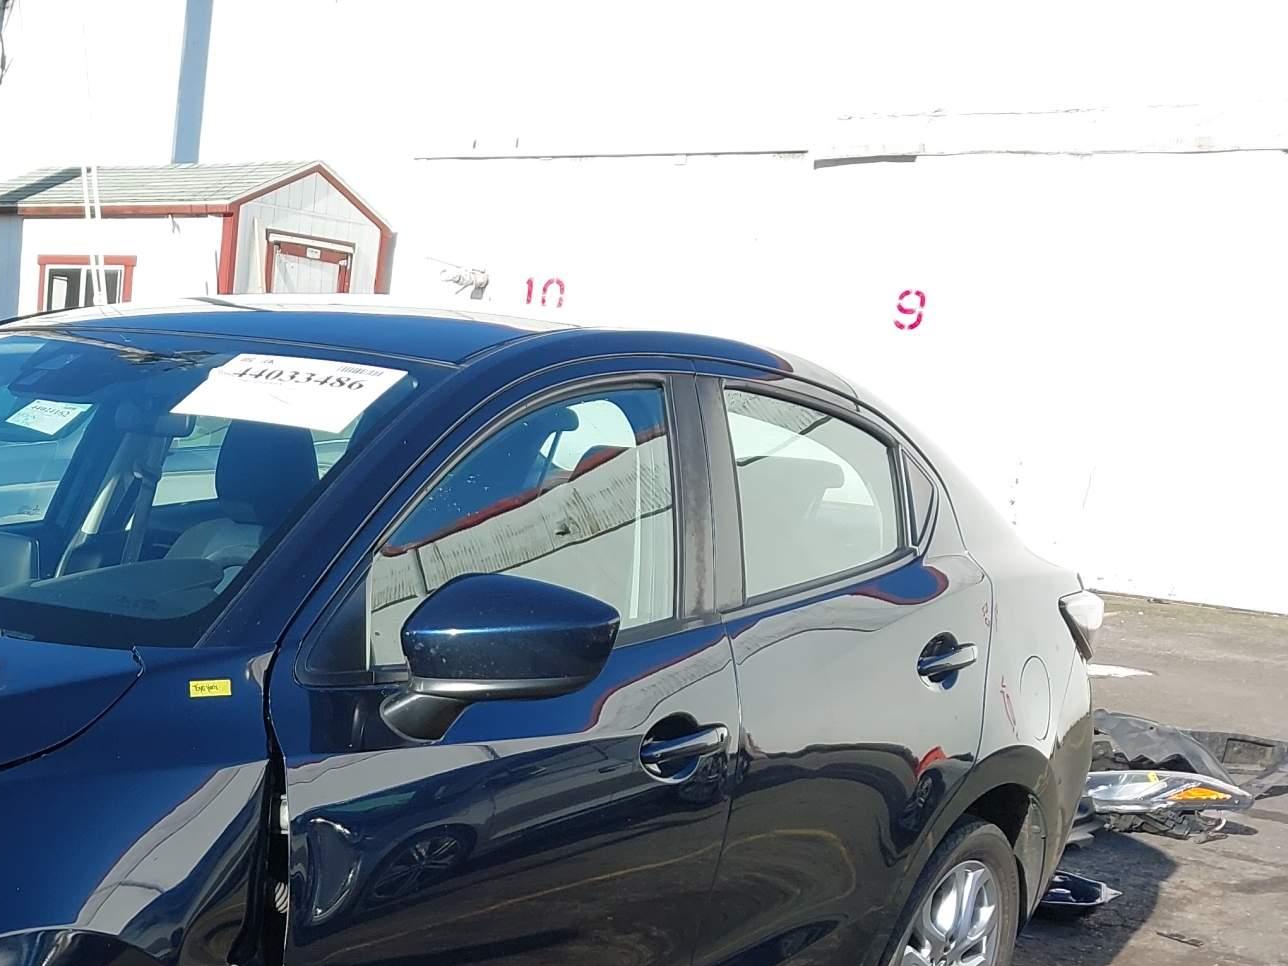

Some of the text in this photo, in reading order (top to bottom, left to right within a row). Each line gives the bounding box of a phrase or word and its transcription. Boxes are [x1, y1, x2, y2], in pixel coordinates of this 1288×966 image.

[525, 278, 565, 308] 10
[893, 288, 927, 331] 9
[233, 366, 369, 391] 44033486
